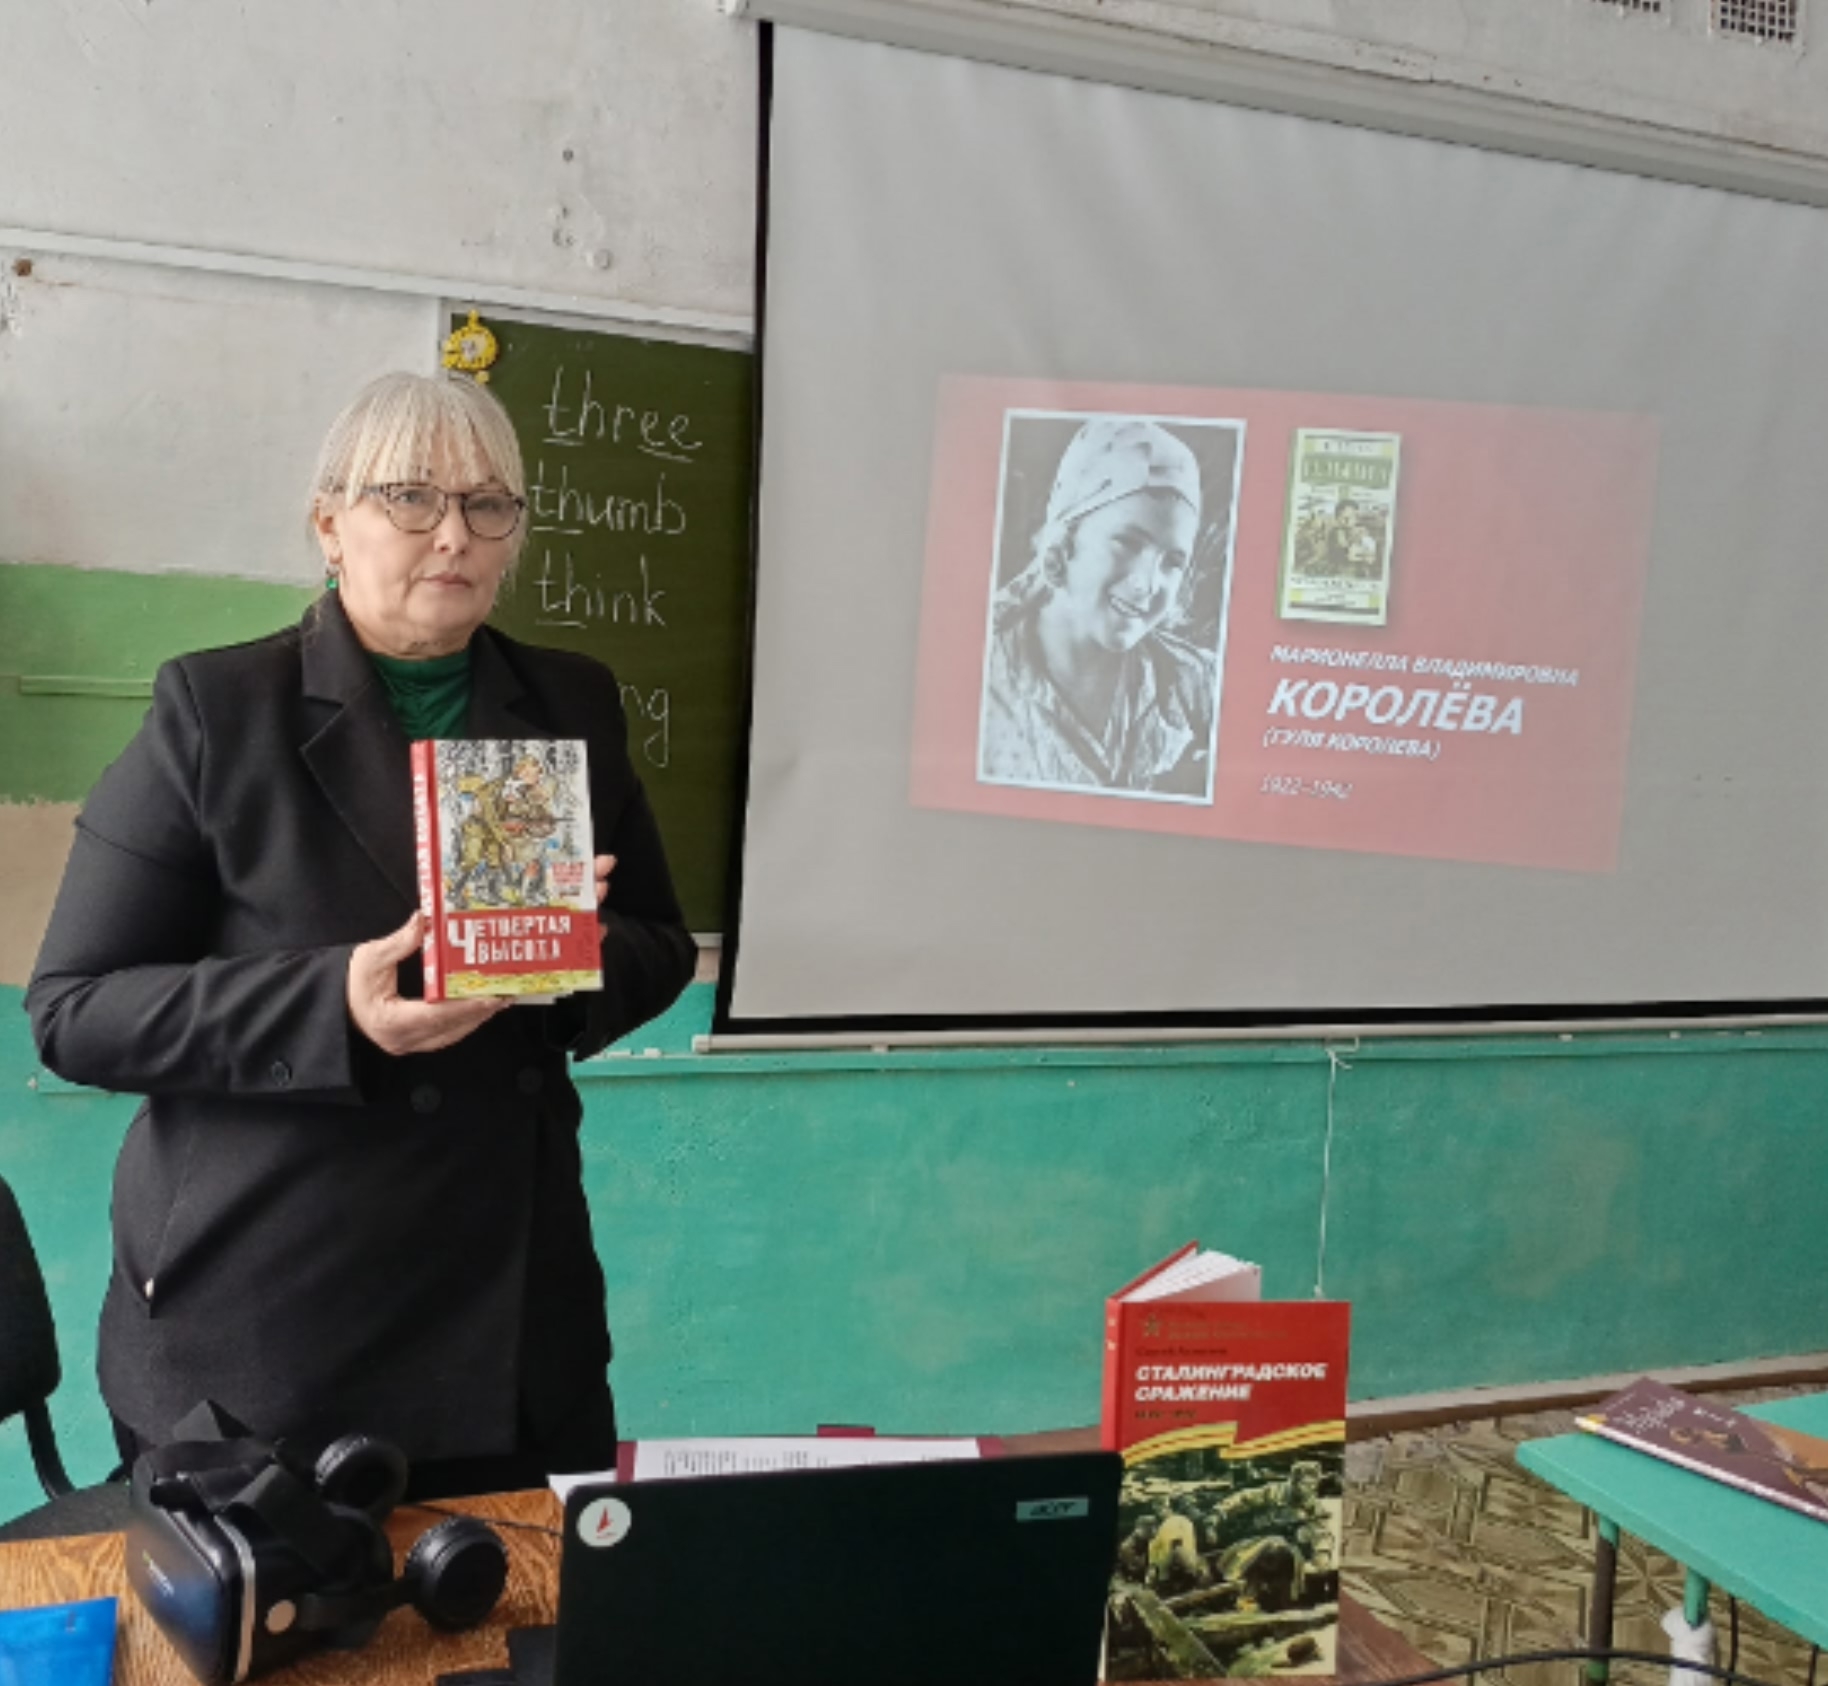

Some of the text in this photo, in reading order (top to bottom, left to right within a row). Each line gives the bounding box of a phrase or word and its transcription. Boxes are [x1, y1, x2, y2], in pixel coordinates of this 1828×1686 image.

[543, 366, 703, 451] three
[530, 460, 686, 535] thumb
[534, 549, 666, 628] think
[1266, 677, 1524, 735] КОРОЛЁВА
[478, 939, 561, 963] ВЫСОТА
[1134, 1383, 1253, 1401] СРАЖЕНИЕ
[1136, 1362, 1328, 1382] СТАЛИНГРАДСКОЕ
